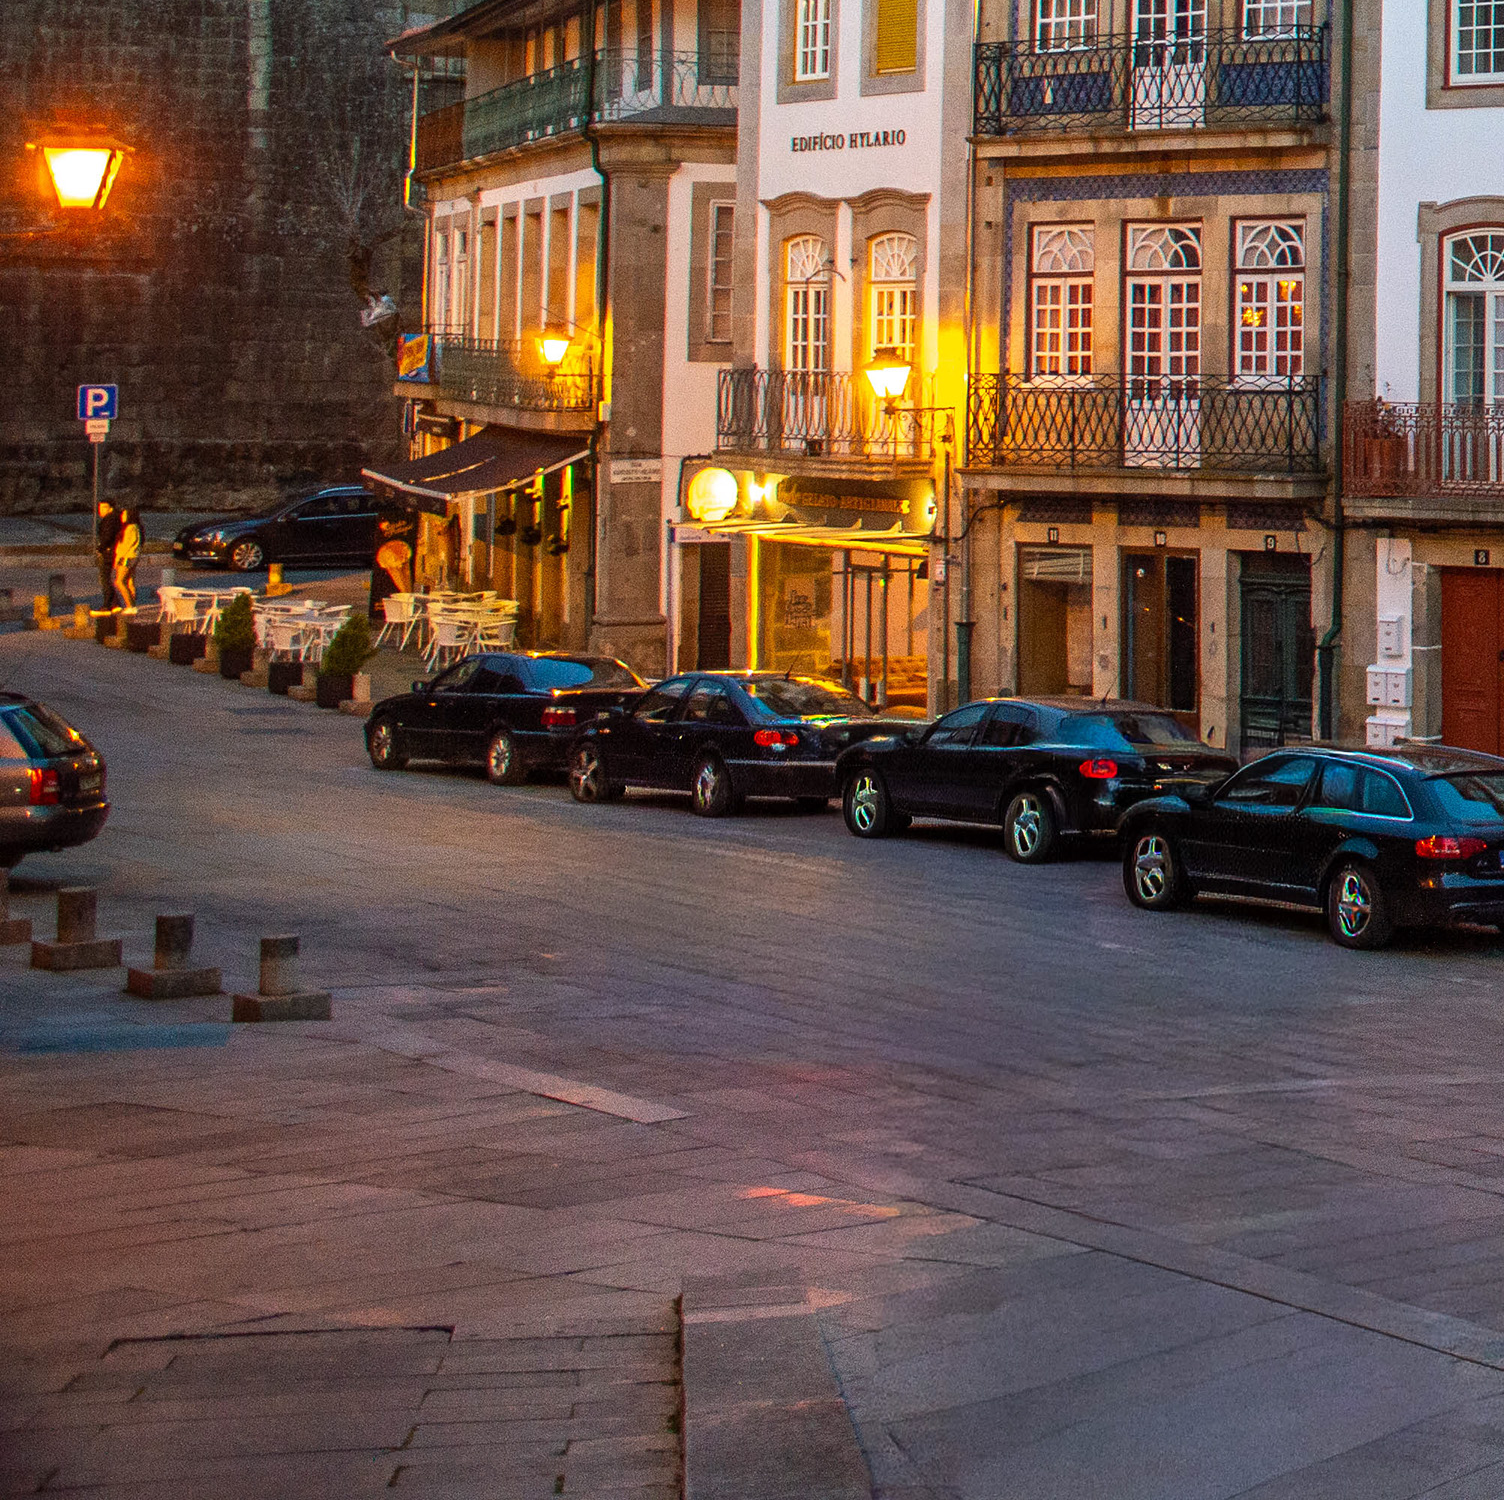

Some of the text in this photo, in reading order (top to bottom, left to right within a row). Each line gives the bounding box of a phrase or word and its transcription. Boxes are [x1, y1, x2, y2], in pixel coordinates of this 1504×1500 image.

[791, 129, 906, 152] EDIFÍCIO HYLARIO
[87, 388, 109, 417] P
[1266, 537, 1274, 549] 9
[1478, 551, 1486, 564] 8
